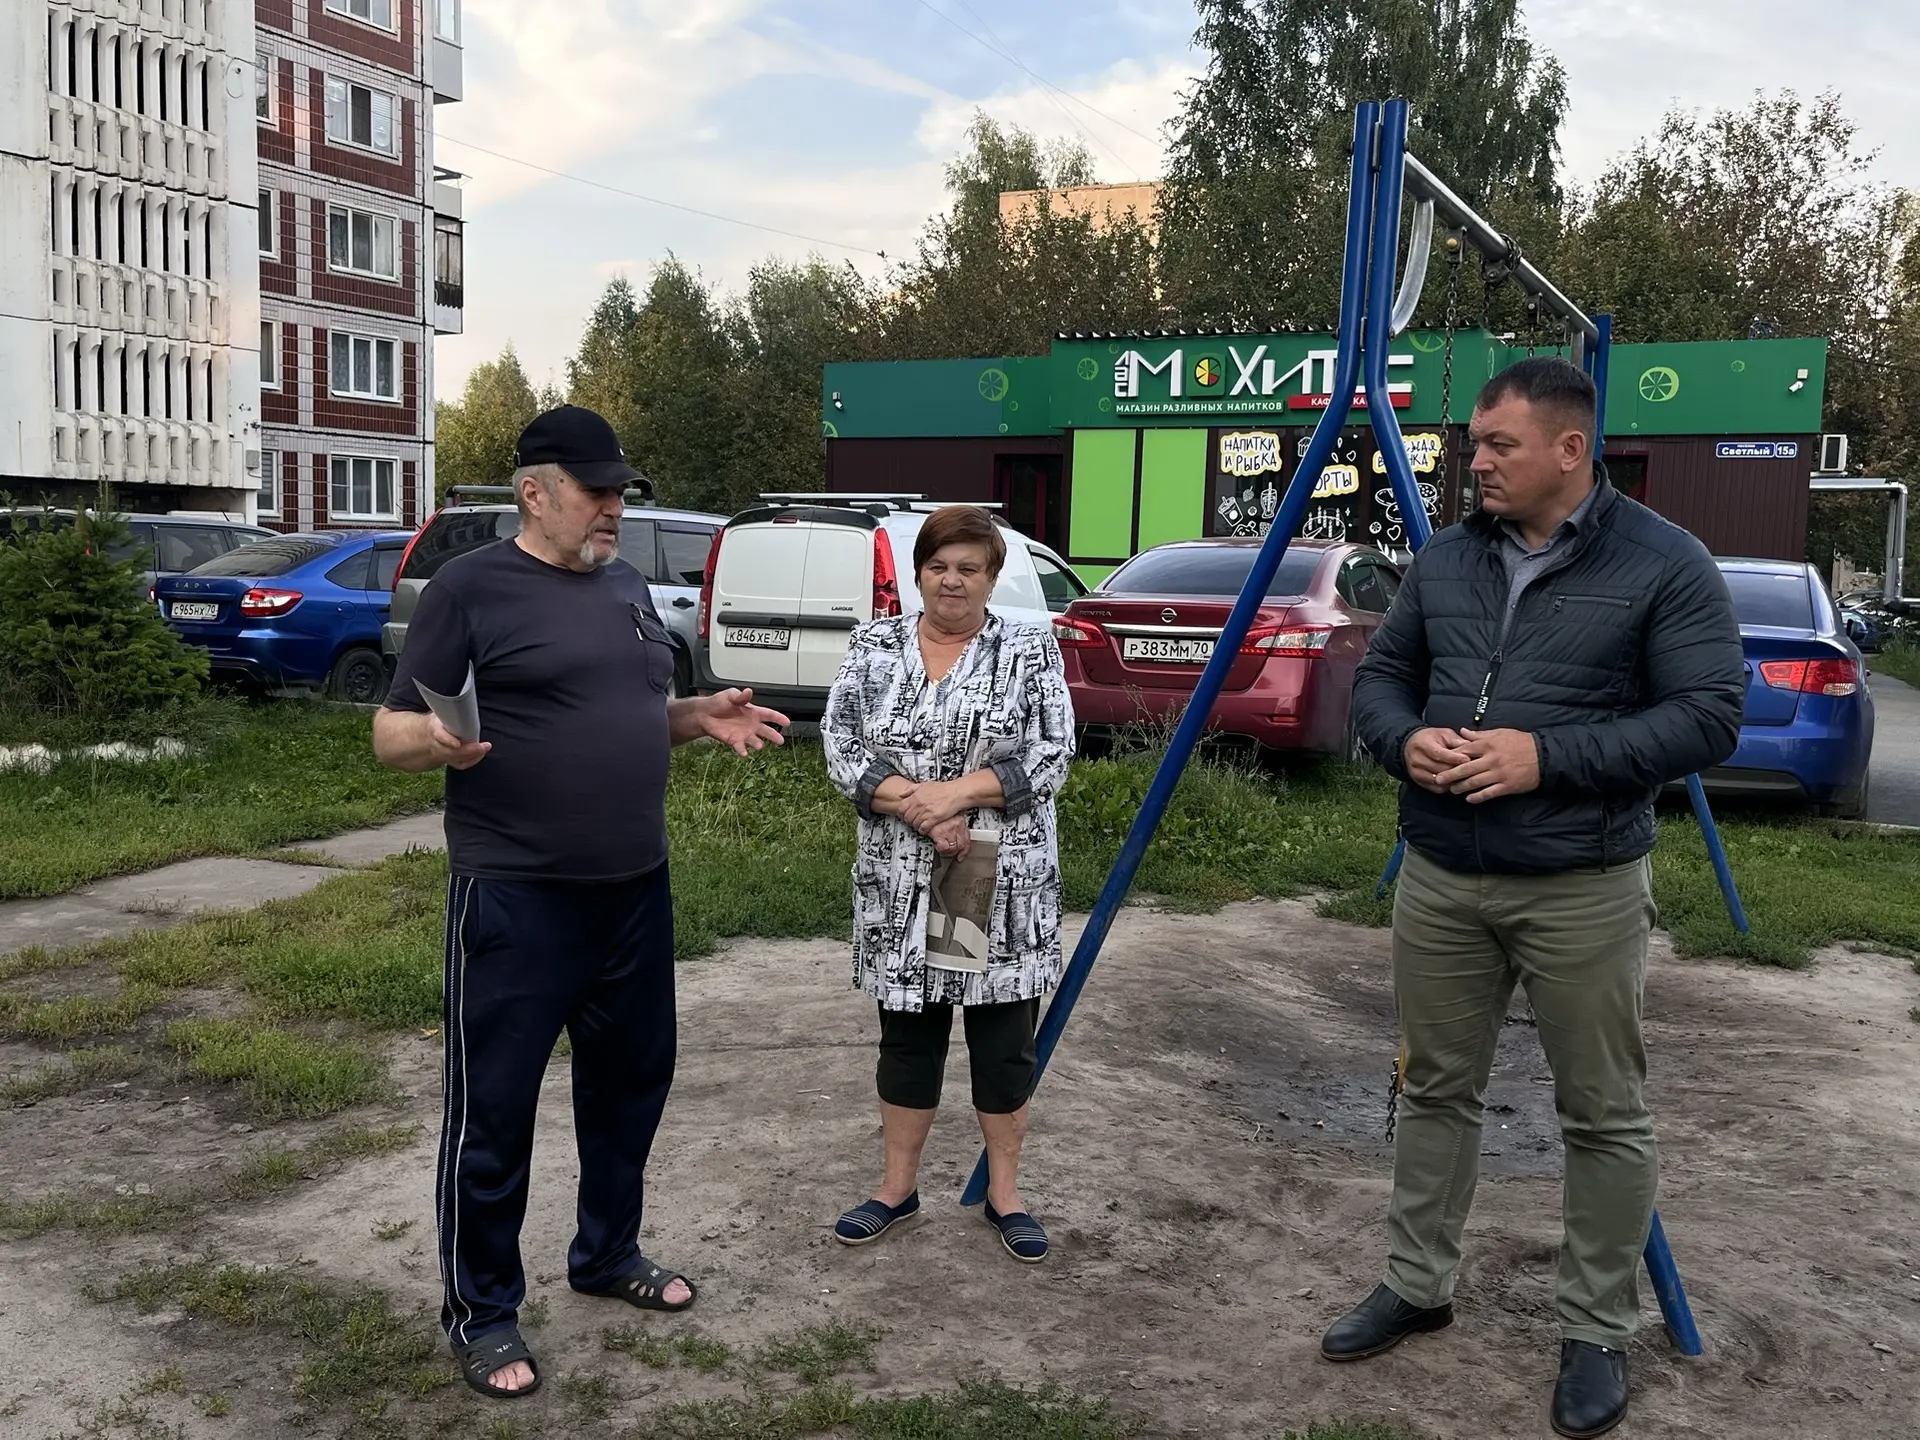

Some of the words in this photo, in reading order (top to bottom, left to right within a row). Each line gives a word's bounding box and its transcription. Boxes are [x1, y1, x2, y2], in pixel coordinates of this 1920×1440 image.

[1116, 404, 1160, 413] МАГАЗИН
[1162, 403, 1222, 412] РАЗЛИВНЫХ
[1227, 402, 1282, 411] НАПИТКОВ
[1224, 436, 1276, 452] НАПИТКИ
[1721, 446, 1770, 455] Светлый
[1778, 446, 1794, 455] 15а
[1224, 455, 1232, 468] И
[1236, 452, 1277, 472] РЫБКА
[1313, 471, 1353, 491] ОРТЫ
[207, 604, 216, 613] 70
[774, 630, 785, 641] 70
[1129, 641, 1189, 657] Р383ММ
[1193, 642, 1209, 654] 70
